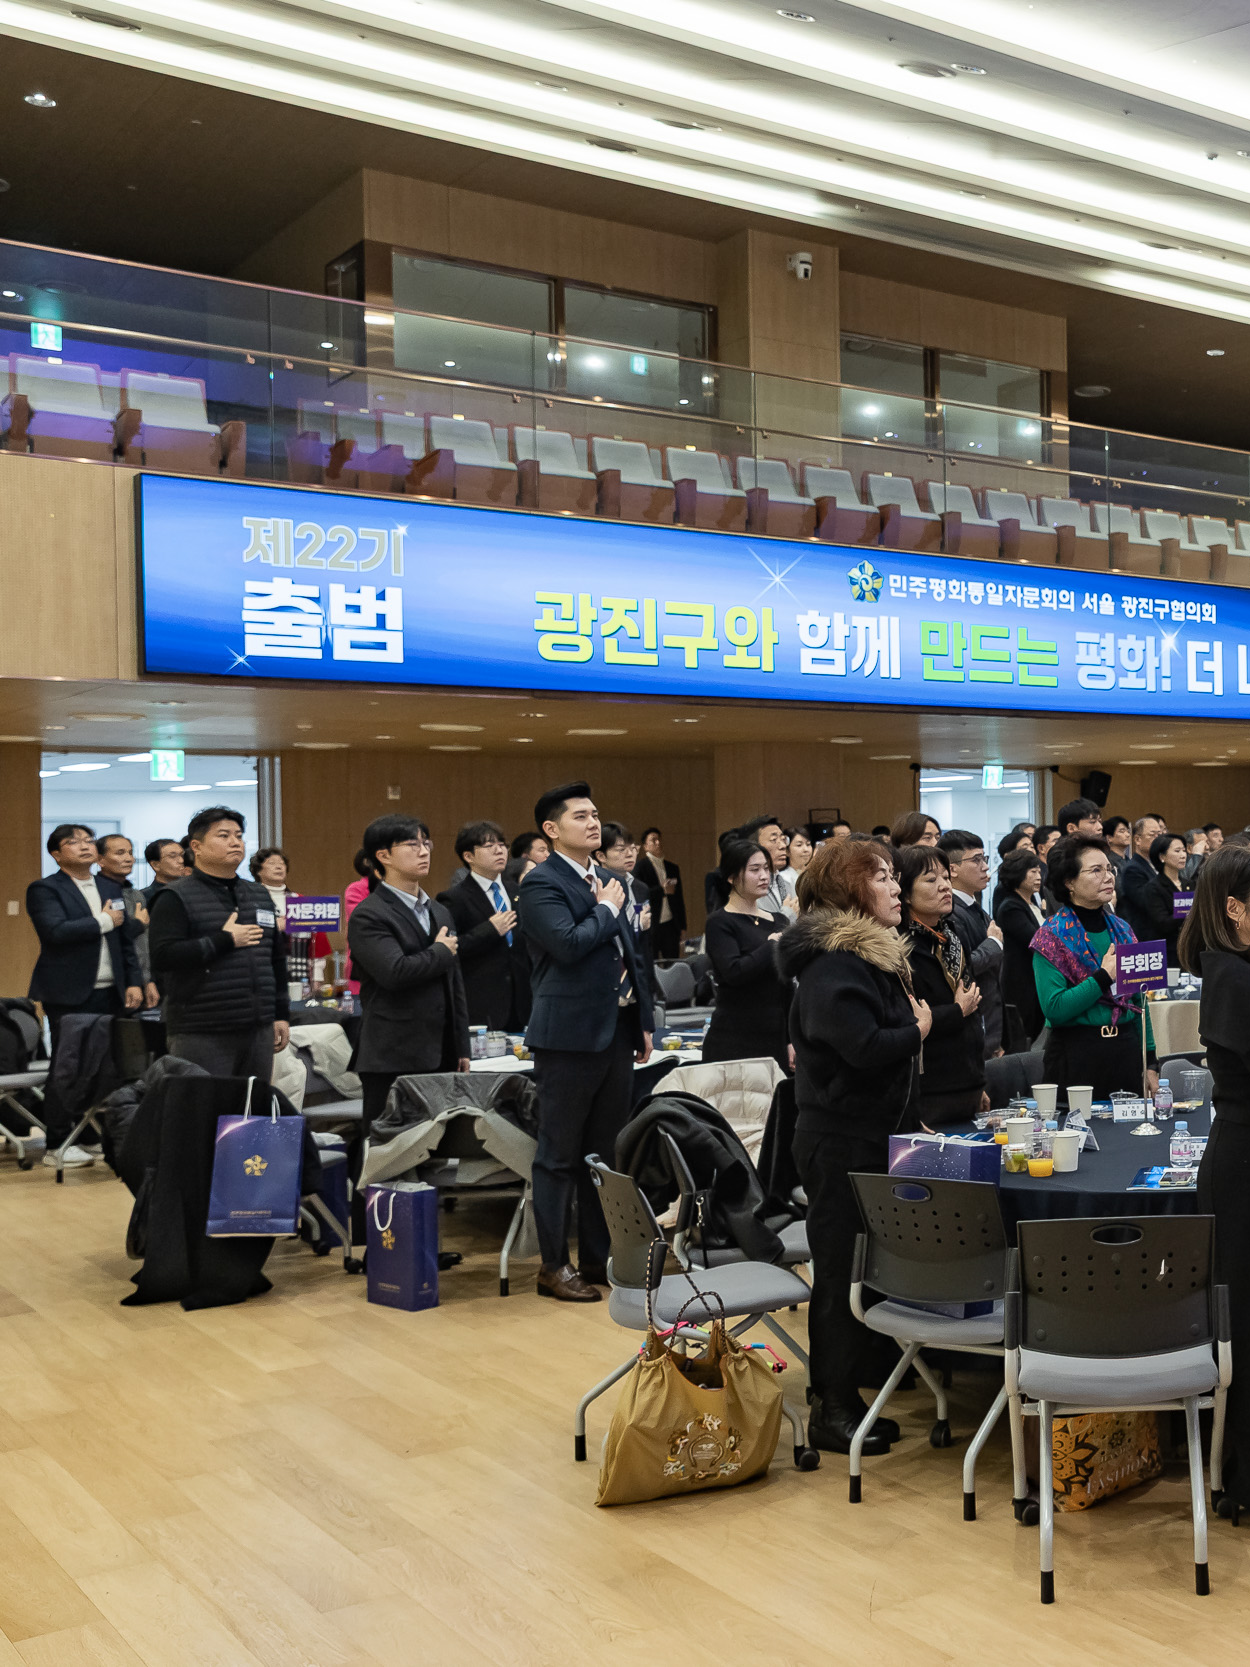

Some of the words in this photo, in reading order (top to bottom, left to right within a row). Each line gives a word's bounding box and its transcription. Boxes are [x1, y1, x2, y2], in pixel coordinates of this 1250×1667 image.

[242, 516, 404, 577] 제22기
[241, 576, 404, 664] 출범
[888, 573, 1075, 612] 민주평화통일자문회의
[1081, 592, 1116, 616] 서울
[1121, 595, 1218, 624] 광진구협의회
[533, 590, 780, 673] 광진구와
[796, 610, 902, 679] 함께
[920, 620, 1060, 688] 만드는
[1075, 631, 1173, 692] 평화!
[1186, 640, 1224, 696] 더
[287, 902, 340, 919] 자문위원
[1120, 951, 1164, 974] 부회장
